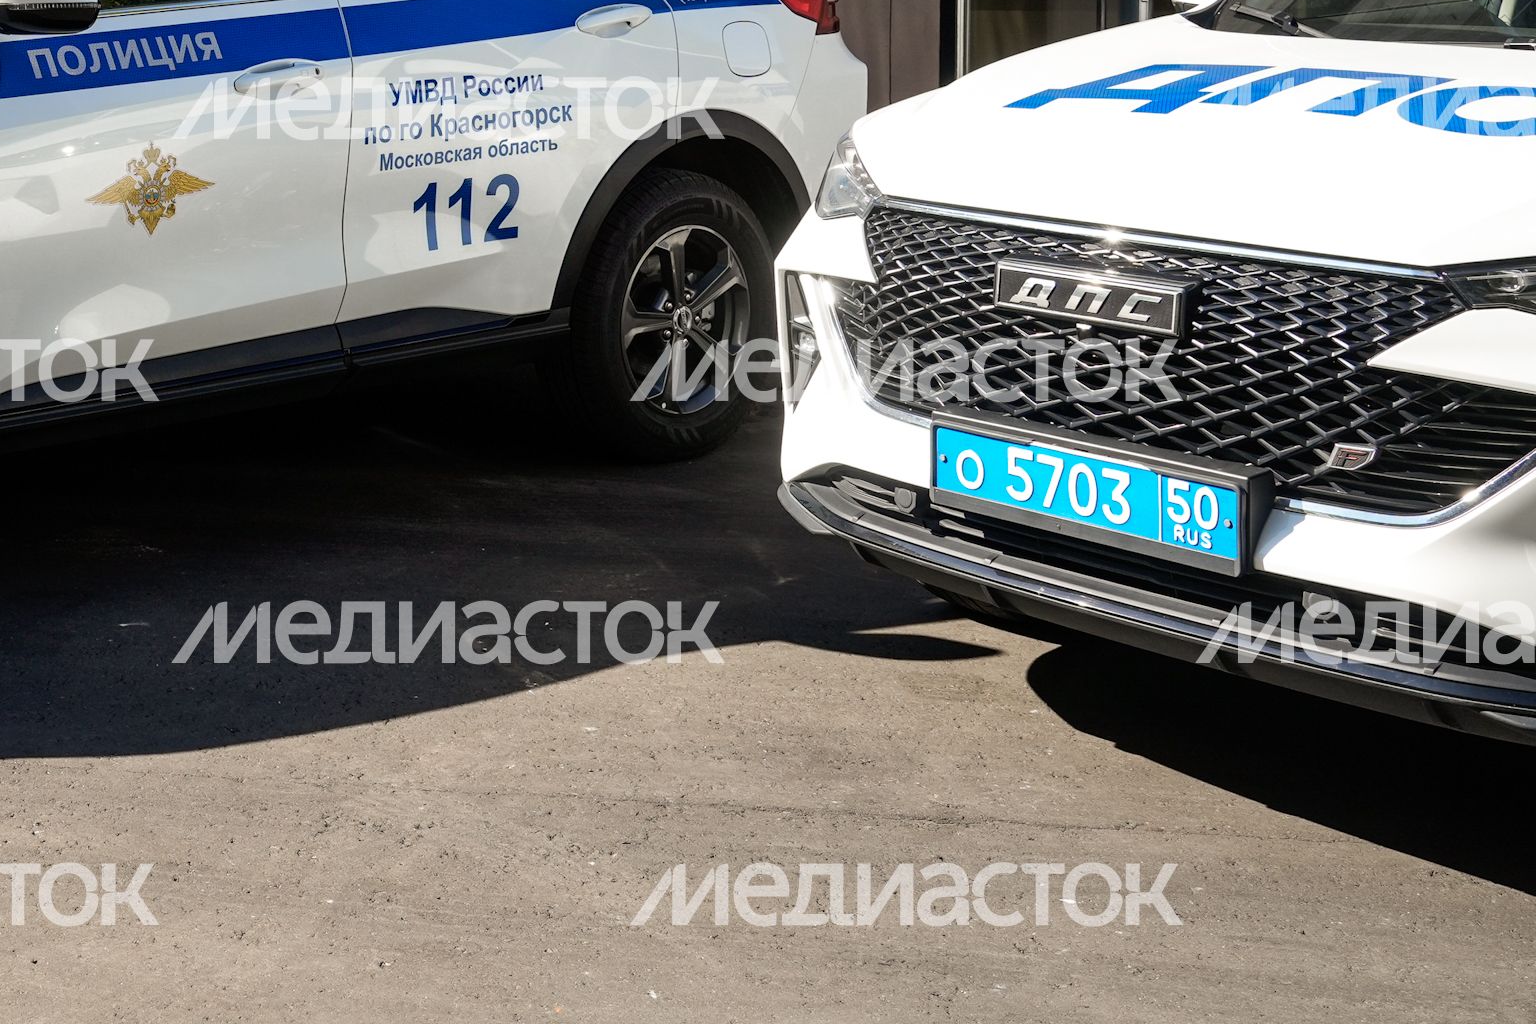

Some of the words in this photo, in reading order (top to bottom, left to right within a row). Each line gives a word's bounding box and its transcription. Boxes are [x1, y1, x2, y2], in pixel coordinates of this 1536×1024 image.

[27, 32, 223, 79] ПОЛИЦИЯ
[389, 78, 457, 106] УМВД
[463, 74, 544, 98] России
[364, 125, 392, 144] по
[400, 121, 422, 141] го
[430, 104, 572, 141] Красногорск
[379, 146, 482, 171] Московская
[488, 137, 558, 159] область
[413, 174, 520, 251] 112
[1009, 277, 1162, 322] ДПС
[1006, 446, 1132, 525] 5703
[1167, 479, 1220, 530] 50
[1174, 524, 1213, 550] RUS
